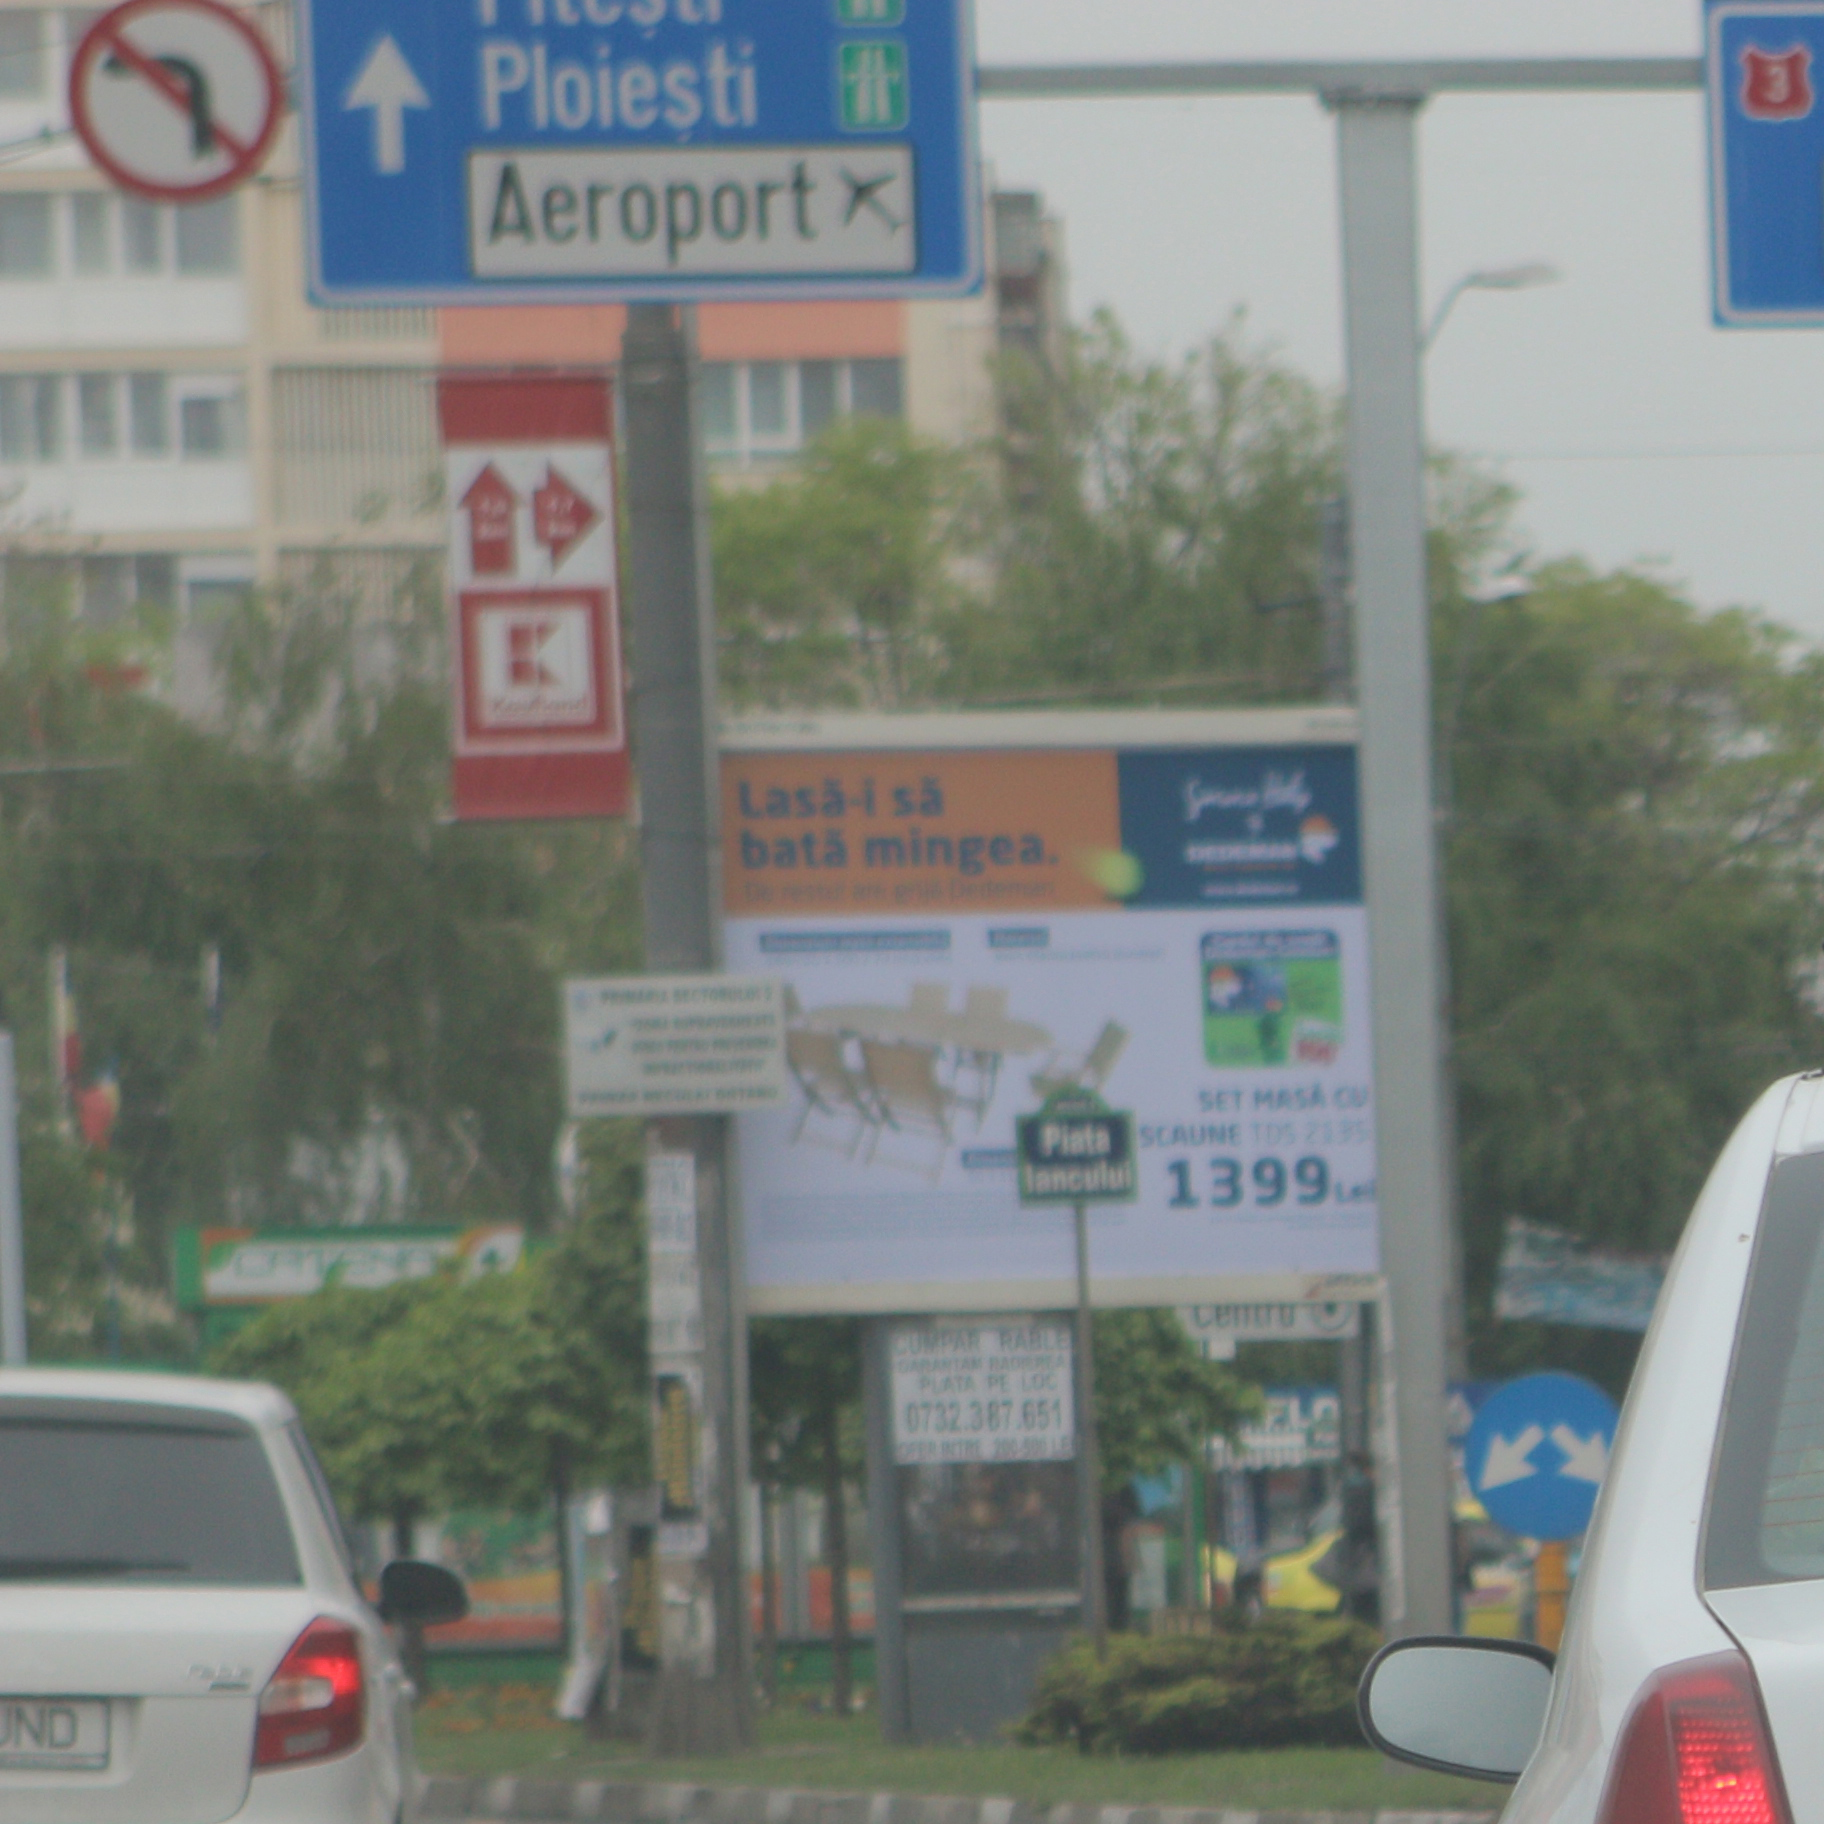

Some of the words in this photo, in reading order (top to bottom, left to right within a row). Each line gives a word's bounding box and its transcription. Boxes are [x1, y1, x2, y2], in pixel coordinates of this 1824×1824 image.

[482, 42, 759, 142] Ploiești
[488, 163, 818, 264] Aeroport
[738, 777, 876, 819] Lasă-i
[892, 776, 944, 818] să
[740, 828, 848, 869] bată
[864, 825, 1060, 877] mingea.
[1198, 1090, 1244, 1113] SET
[1252, 1083, 1326, 1110] MASĂ
[1332, 1085, 1369, 1108] CU
[1139, 1124, 1242, 1149] SCAUNE
[1166, 1155, 1331, 1209] 1399
[1192, 1302, 1297, 1330] Centru
[918, 1375, 976, 1394] PLATA
[987, 1373, 1011, 1391] PE
[1020, 1371, 1059, 1391] LOC
